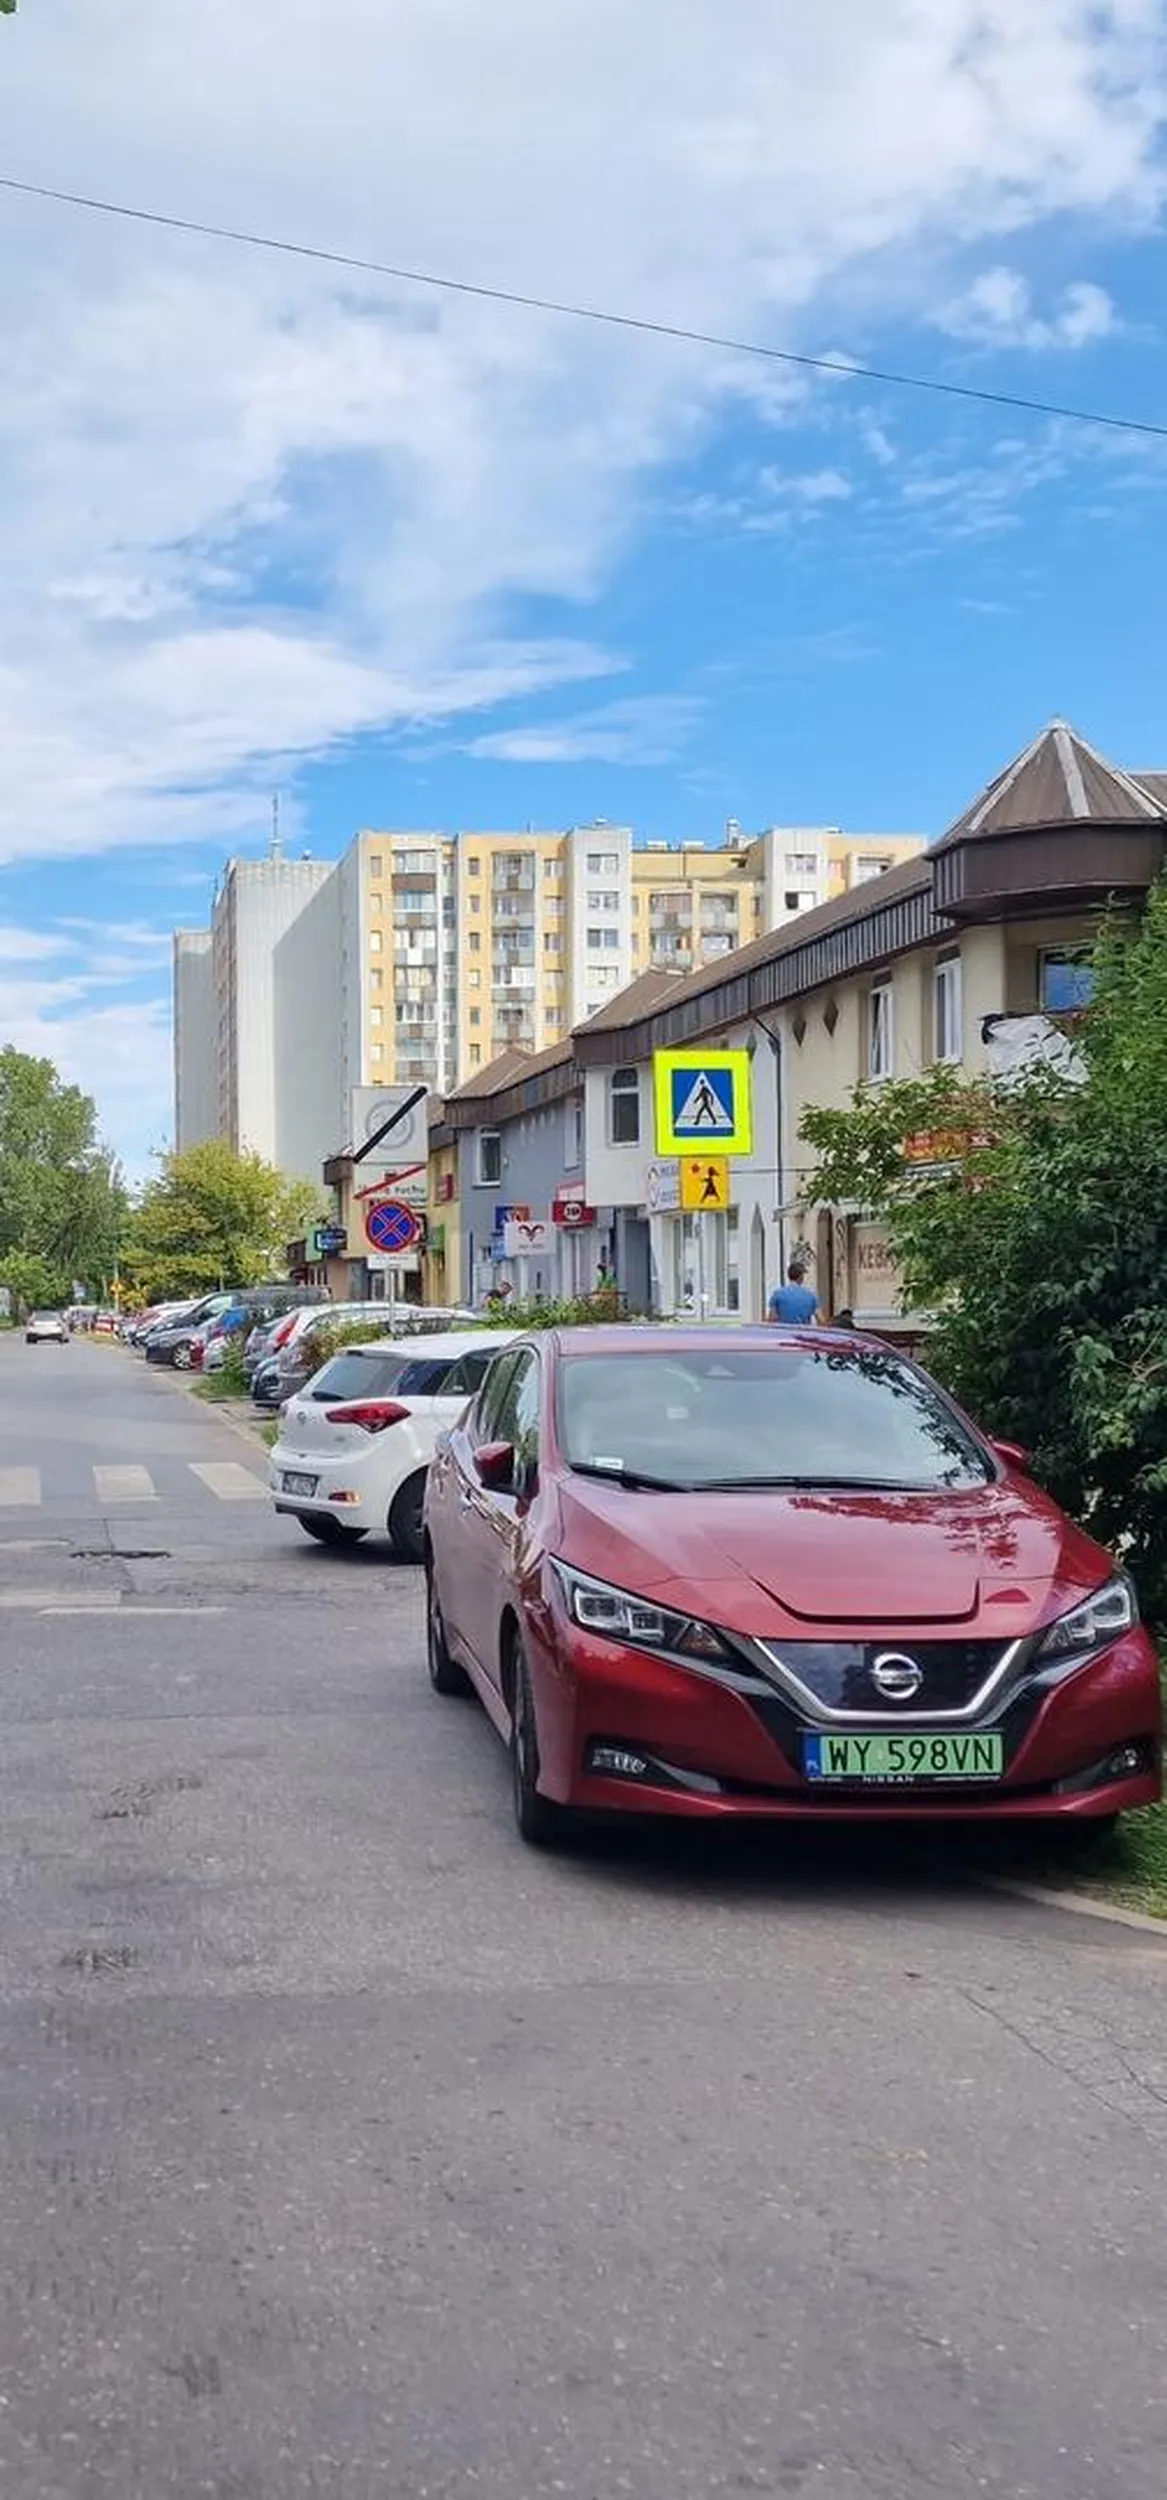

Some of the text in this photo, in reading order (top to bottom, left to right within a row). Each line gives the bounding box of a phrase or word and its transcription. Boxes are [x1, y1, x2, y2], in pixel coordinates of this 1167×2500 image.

[828, 1739, 994, 1772] WY 598VN
[862, 1776, 915, 1784] NISSAN
